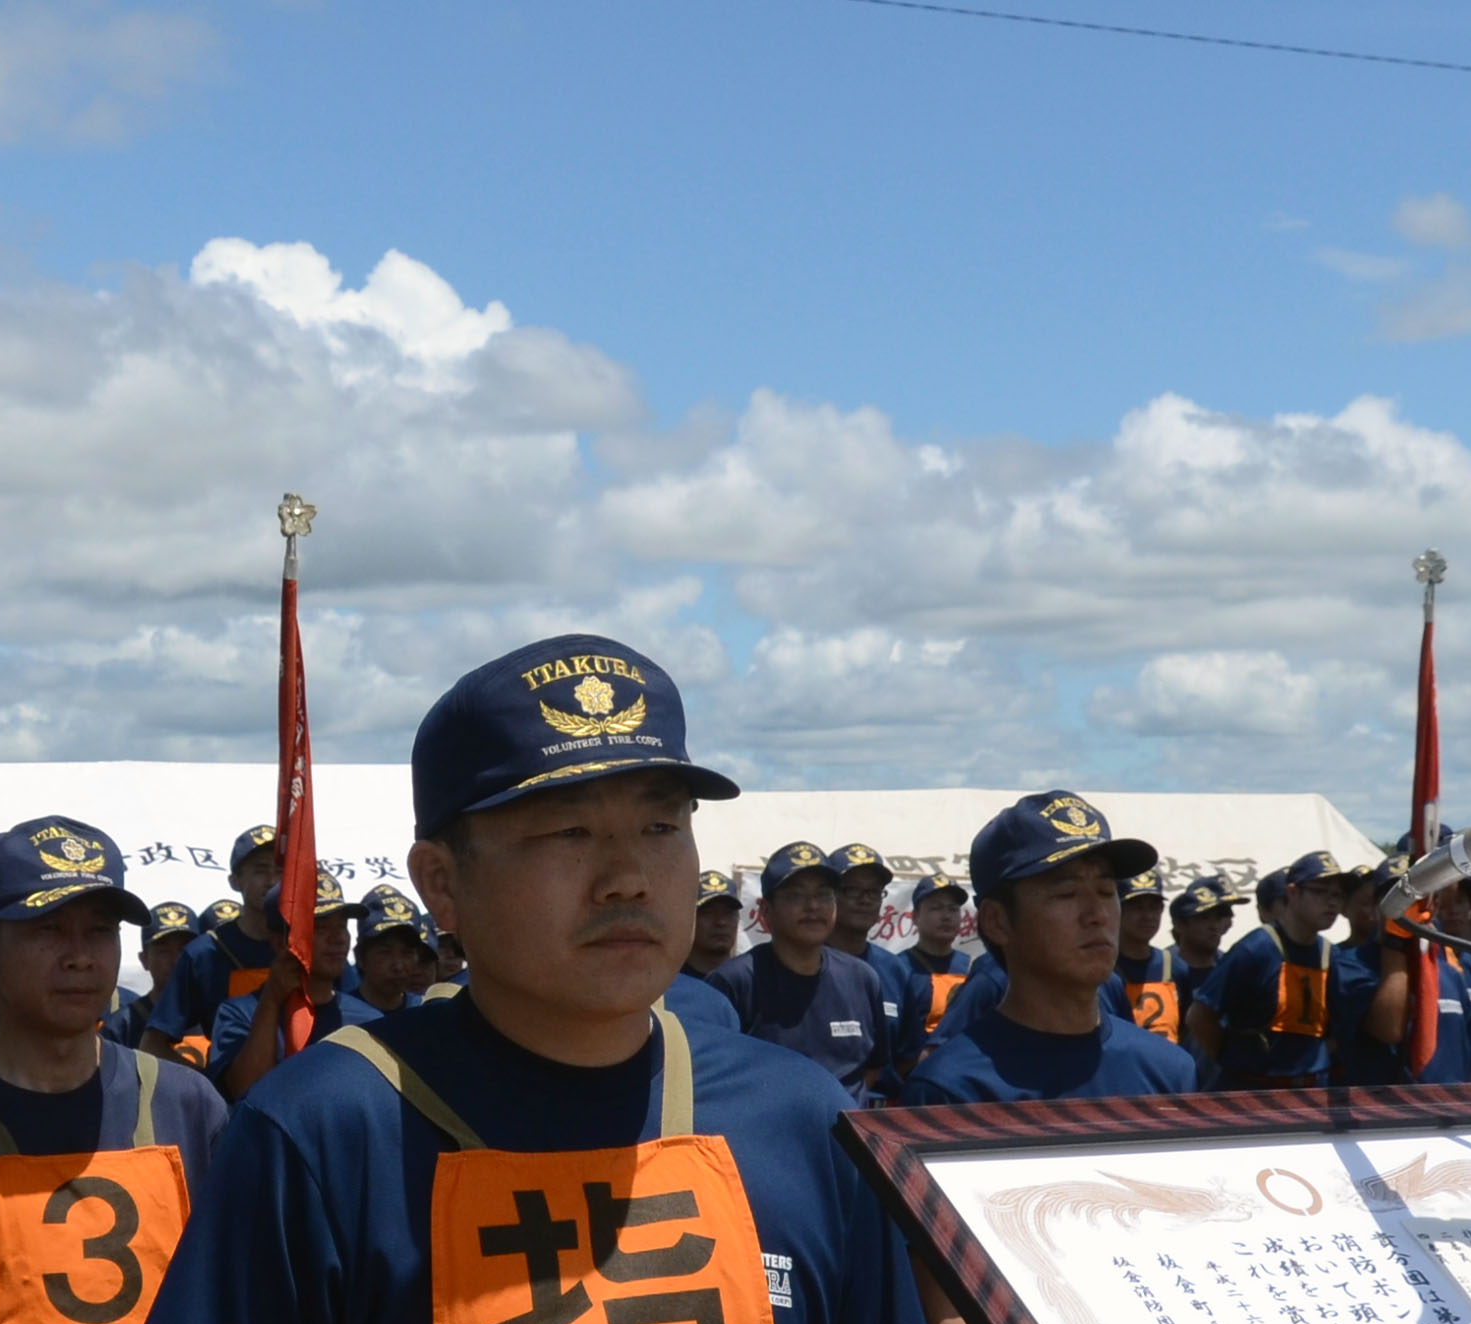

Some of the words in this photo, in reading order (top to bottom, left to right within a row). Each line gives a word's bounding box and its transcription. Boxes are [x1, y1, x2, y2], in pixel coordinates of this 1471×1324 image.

[521, 655, 646, 691] ITAKURA
[542, 737, 602, 756] VOLUNTEER
[42, 1176, 143, 1324] 3
